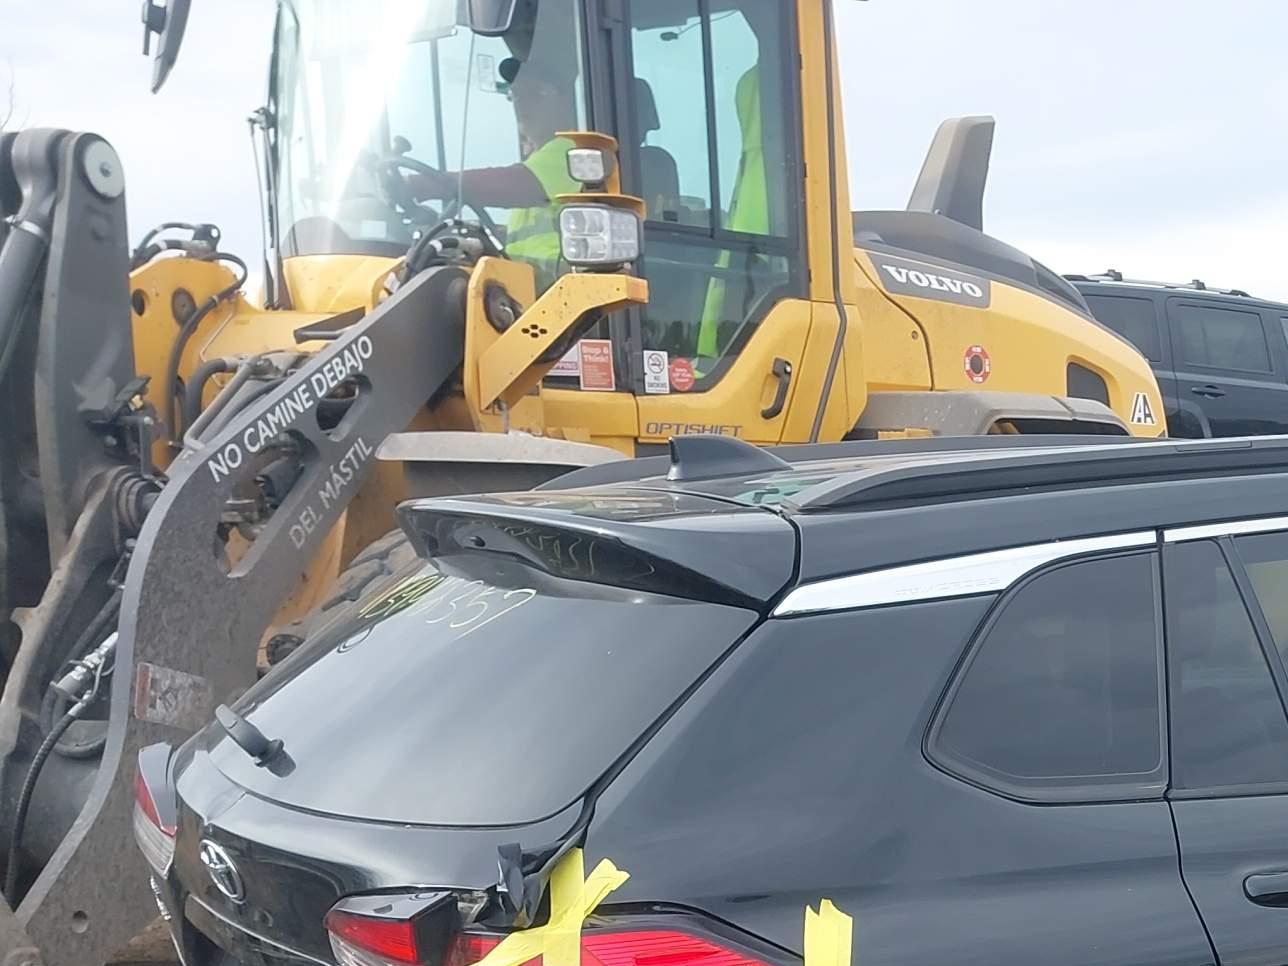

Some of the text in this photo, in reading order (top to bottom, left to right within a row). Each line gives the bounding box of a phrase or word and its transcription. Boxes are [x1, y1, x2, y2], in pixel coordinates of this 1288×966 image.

[882, 264, 983, 298] VOLVO
[207, 335, 373, 482] NO CAMINE DEBAJO
[646, 422, 743, 437] OPTISHIFT
[289, 437, 373, 548] DEL MÁSTIL
